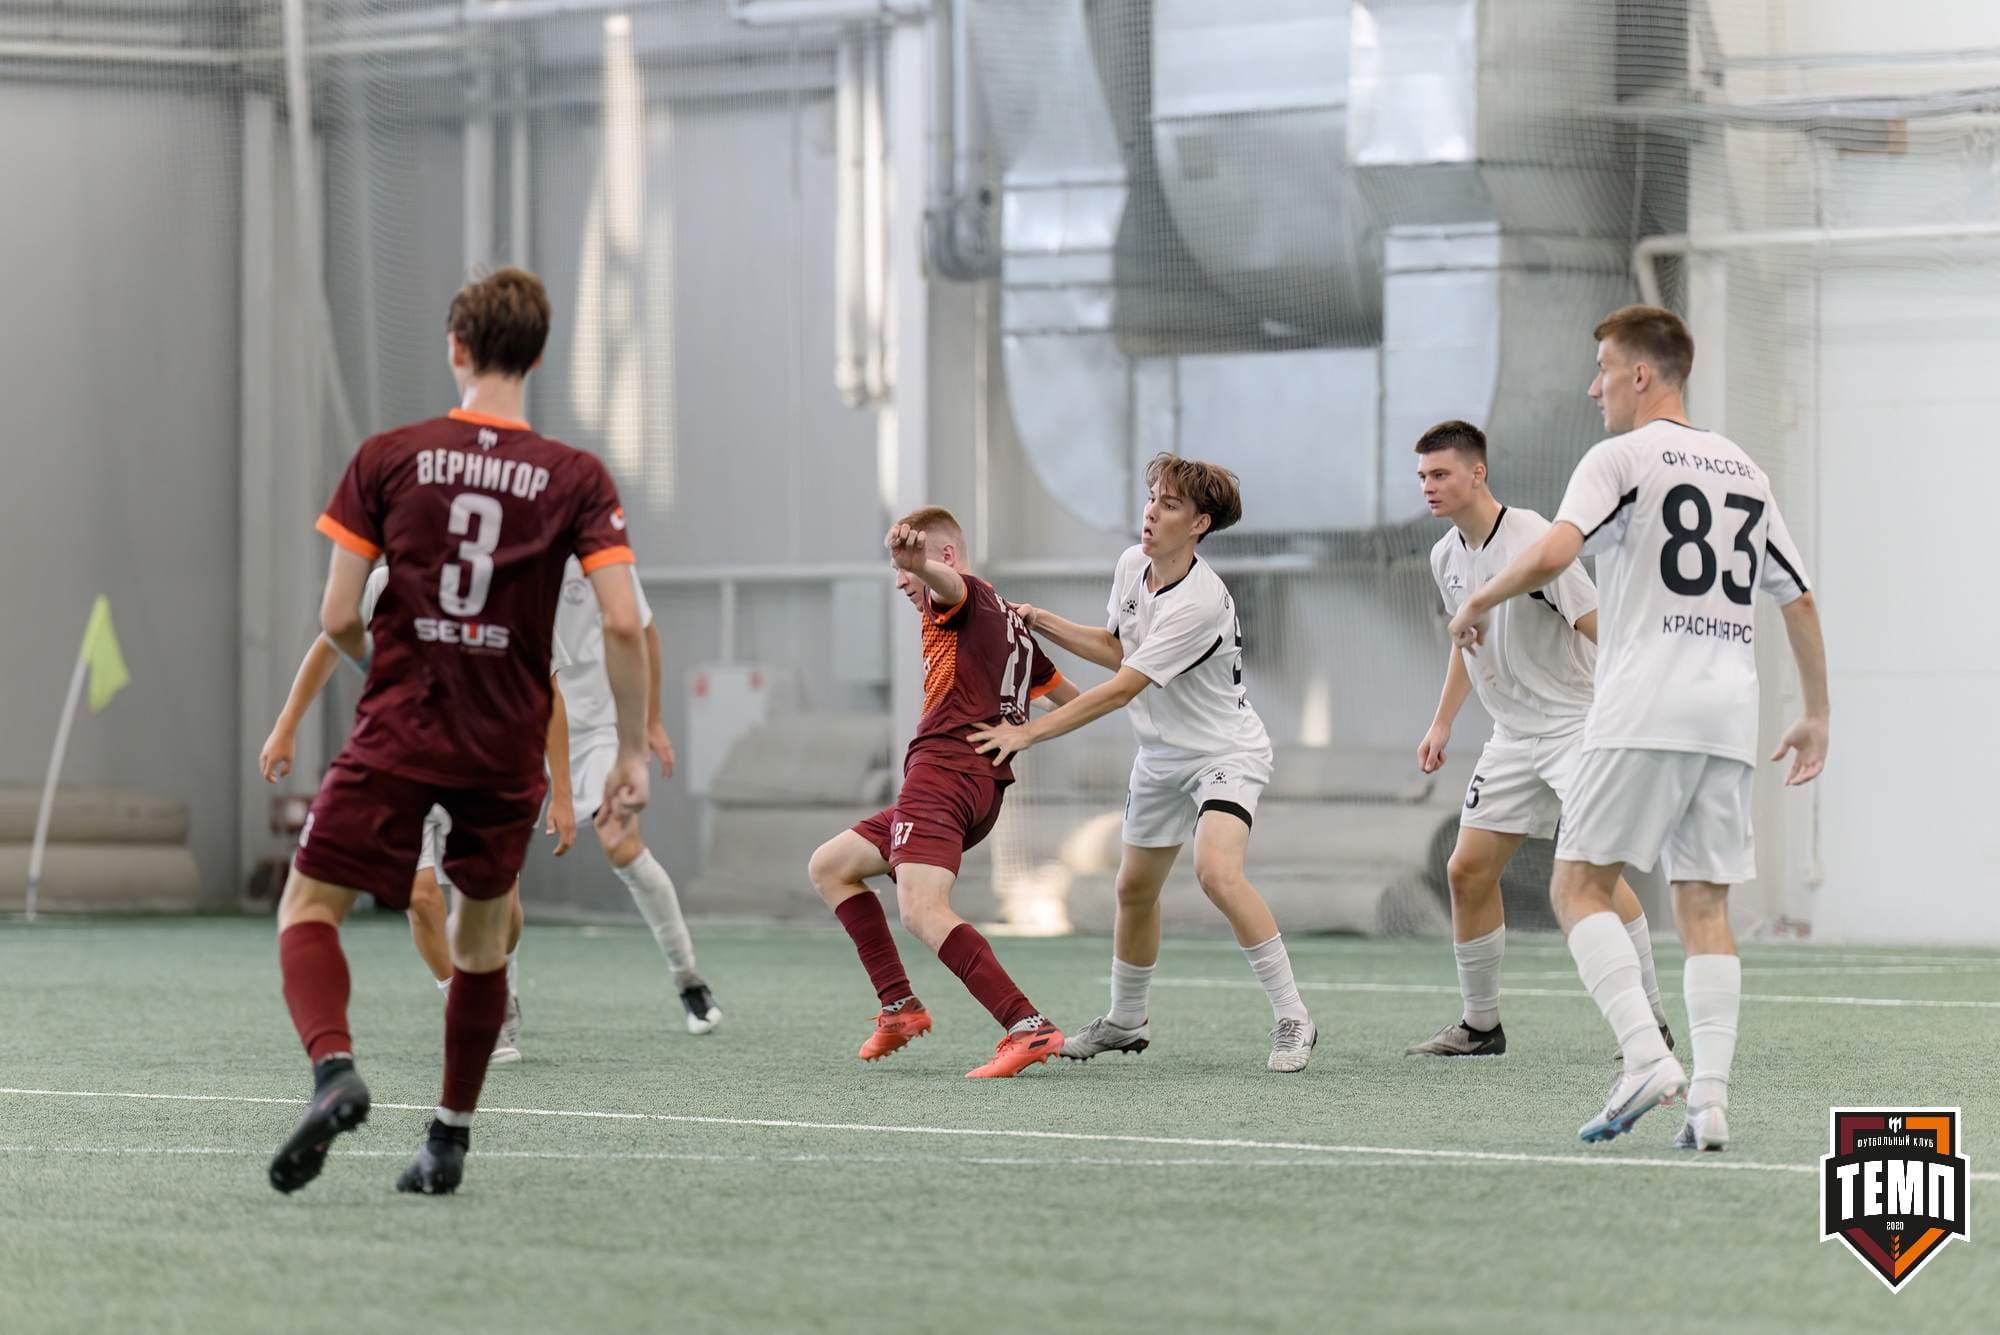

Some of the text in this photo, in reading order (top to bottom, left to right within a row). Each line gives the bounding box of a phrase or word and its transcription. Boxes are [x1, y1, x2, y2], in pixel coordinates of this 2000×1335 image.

[416, 448, 550, 500] ВЕРНИГОР
[1662, 450, 1755, 480] ФК РАССВЕ
[438, 493, 503, 617] 3
[1660, 483, 1765, 605] 83
[414, 618, 509, 649] SEUS
[1465, 774, 1485, 809] 5
[894, 822, 914, 846] 27
